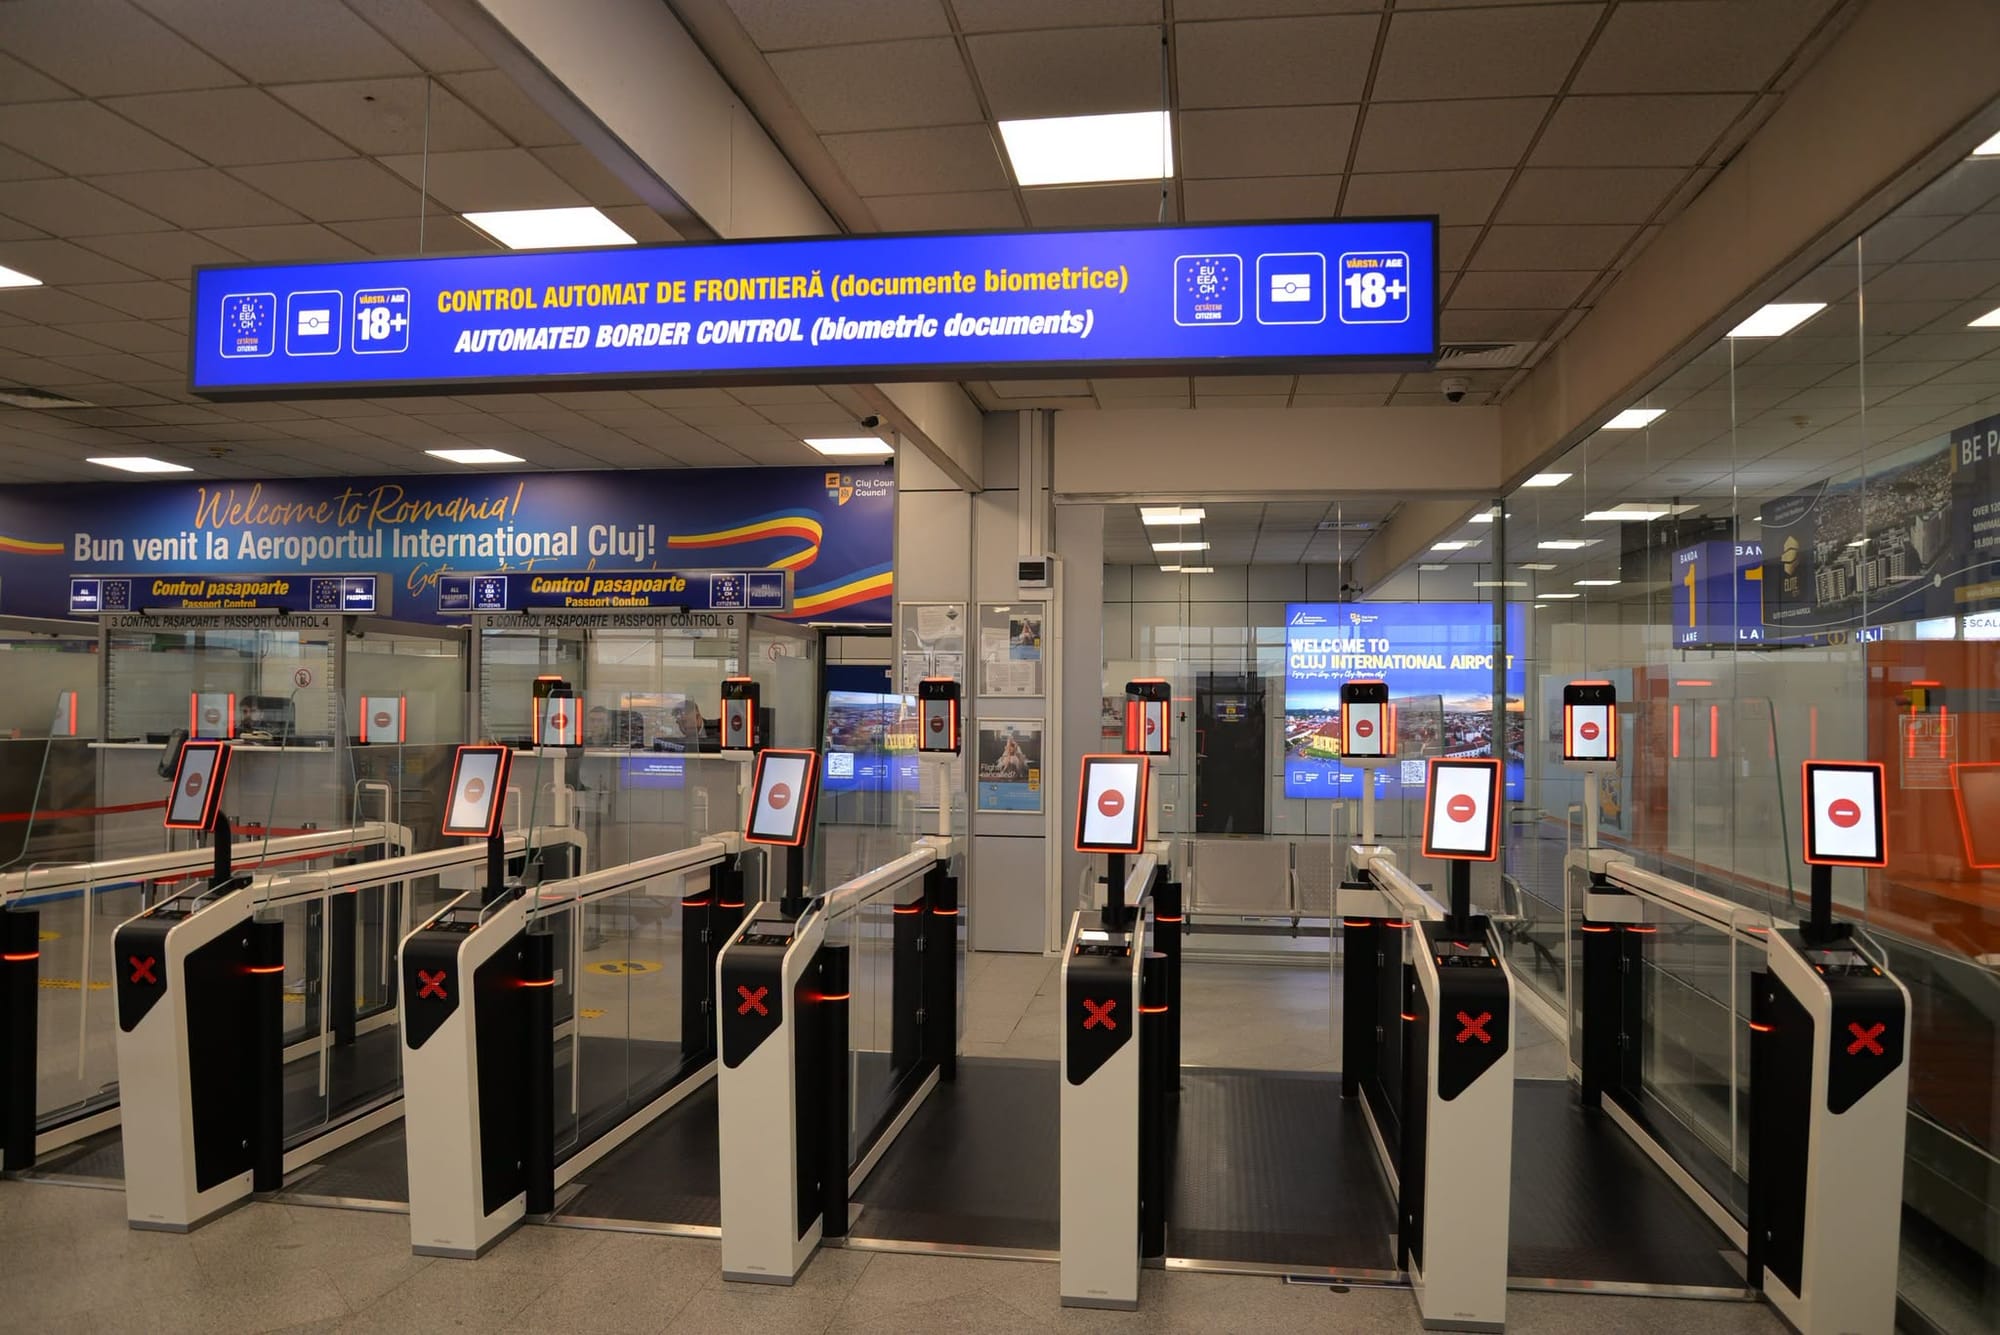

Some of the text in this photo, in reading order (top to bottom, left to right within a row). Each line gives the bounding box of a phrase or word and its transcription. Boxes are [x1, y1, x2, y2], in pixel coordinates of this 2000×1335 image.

[1385, 258, 1403, 267] AGE
[1200, 266, 1215, 275] EU
[1197, 275, 1218, 284] EEA
[437, 265, 1129, 313] CONTROL AUTOMAT DE FRONTIERĂ (documente biometrice)
[1200, 284, 1215, 293] CH
[1345, 272, 1407, 309] 18+
[391, 294, 405, 302] AGE
[242, 304, 254, 312] EU
[239, 312, 256, 320] EEA
[1195, 311, 1221, 319] CITIZENS
[241, 320, 254, 329] CH
[357, 307, 407, 340] 18+
[454, 309, 1094, 353] AUTOMATED BORDER CONTROL (biometric documents)
[1962, 435, 1982, 466] BE
[856, 479, 894, 489] Cluj Coun
[856, 488, 887, 496] Council
[194, 481, 524, 531] Welcome to Romania!
[73, 532, 124, 562] Bun
[132, 531, 198, 562] venit
[205, 531, 229, 561] la
[237, 528, 382, 566] Aeroportul
[392, 524, 578, 566] Internațional
[588, 524, 655, 562] Cluj!
[1735, 546, 1762, 555] BAN
[1680, 551, 1698, 564] BANDA
[152, 579, 289, 598] Control pasapoarte
[531, 575, 686, 596] Control pasapoarte
[1684, 563, 1696, 628] 1
[182, 599, 256, 608] Passport Control
[565, 596, 649, 607] Passport Control
[112, 616, 117, 627] 3
[120, 616, 160, 627] CONTROL
[224, 615, 272, 627] PASSPORT
[274, 615, 319, 627] CONTROL
[322, 616, 329, 627] 4
[486, 616, 494, 627] 5
[496, 615, 540, 627] CONTROL
[613, 614, 668, 627] PASSPORT
[671, 614, 721, 626] CONTROL
[727, 615, 734, 626] 6
[1970, 618, 2000, 628] SCAL
[1682, 632, 1698, 643] LANE
[1740, 629, 1764, 639] LA
[1290, 638, 1389, 653] WELCOME TO
[1290, 654, 1514, 670] CLUJ INTERNATIONAL AIRPOT
